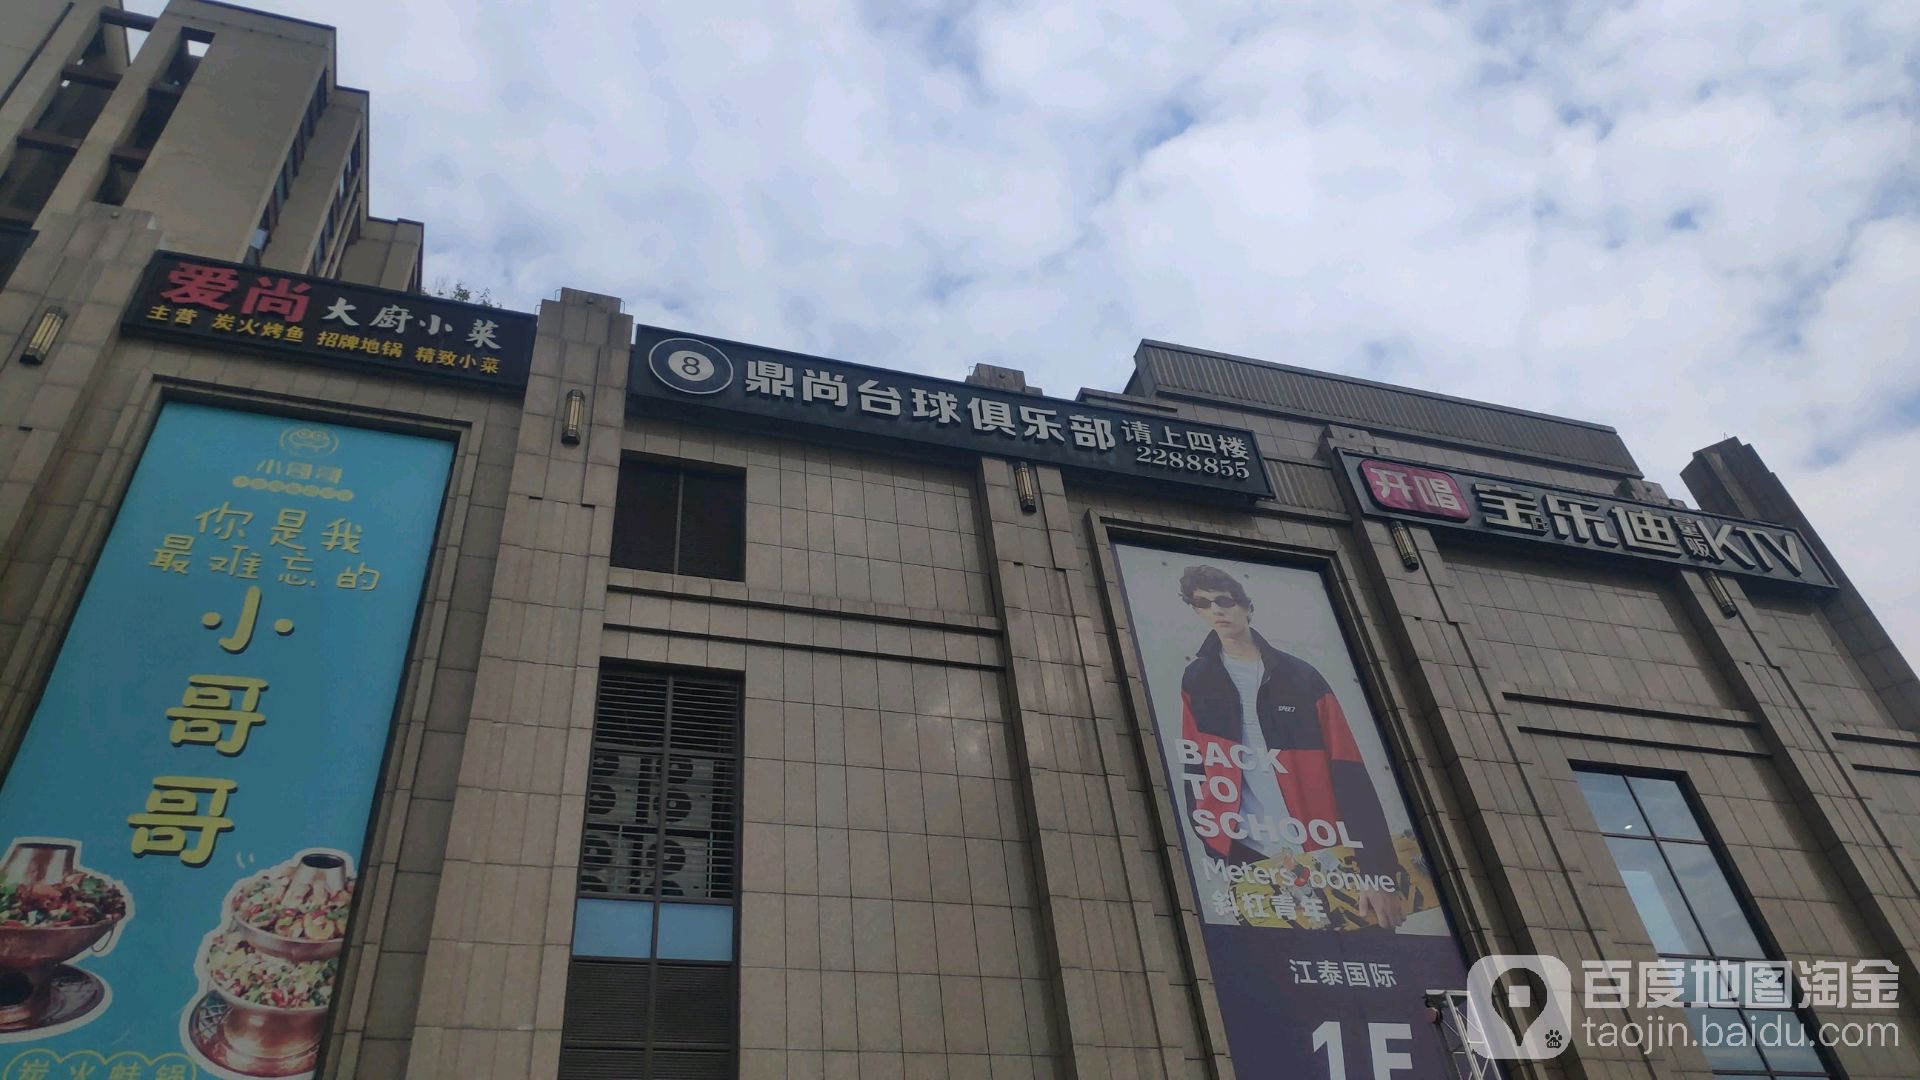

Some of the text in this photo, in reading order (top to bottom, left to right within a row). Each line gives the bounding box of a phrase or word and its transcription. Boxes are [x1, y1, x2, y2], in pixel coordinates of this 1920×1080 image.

[160, 261, 502, 350] 爱尚 大厨小菜
[146, 304, 501, 375] 主营 炭火烤鱼 招牌地锅 精致小菜
[681, 356, 701, 376] 8
[745, 360, 1116, 450] 鼎尚台球俱乐部
[1121, 419, 1250, 460] 请上四楼
[1136, 446, 1250, 479] 2288855
[1368, 467, 1462, 511] 开唱
[194, 501, 363, 554] 你是我
[1474, 483, 1683, 558] 宝乐迪
[149, 533, 381, 591] 最难忘的
[1695, 519, 1802, 575] KTV
[128, 585, 294, 866] 小哥哥
[1175, 738, 1289, 775] BACK
[1182, 773, 1238, 804] TO
[1192, 809, 1364, 849] SCHOOL
[1212, 889, 1327, 921] 斜杠青年
[1289, 958, 1398, 988] 江泰国际
